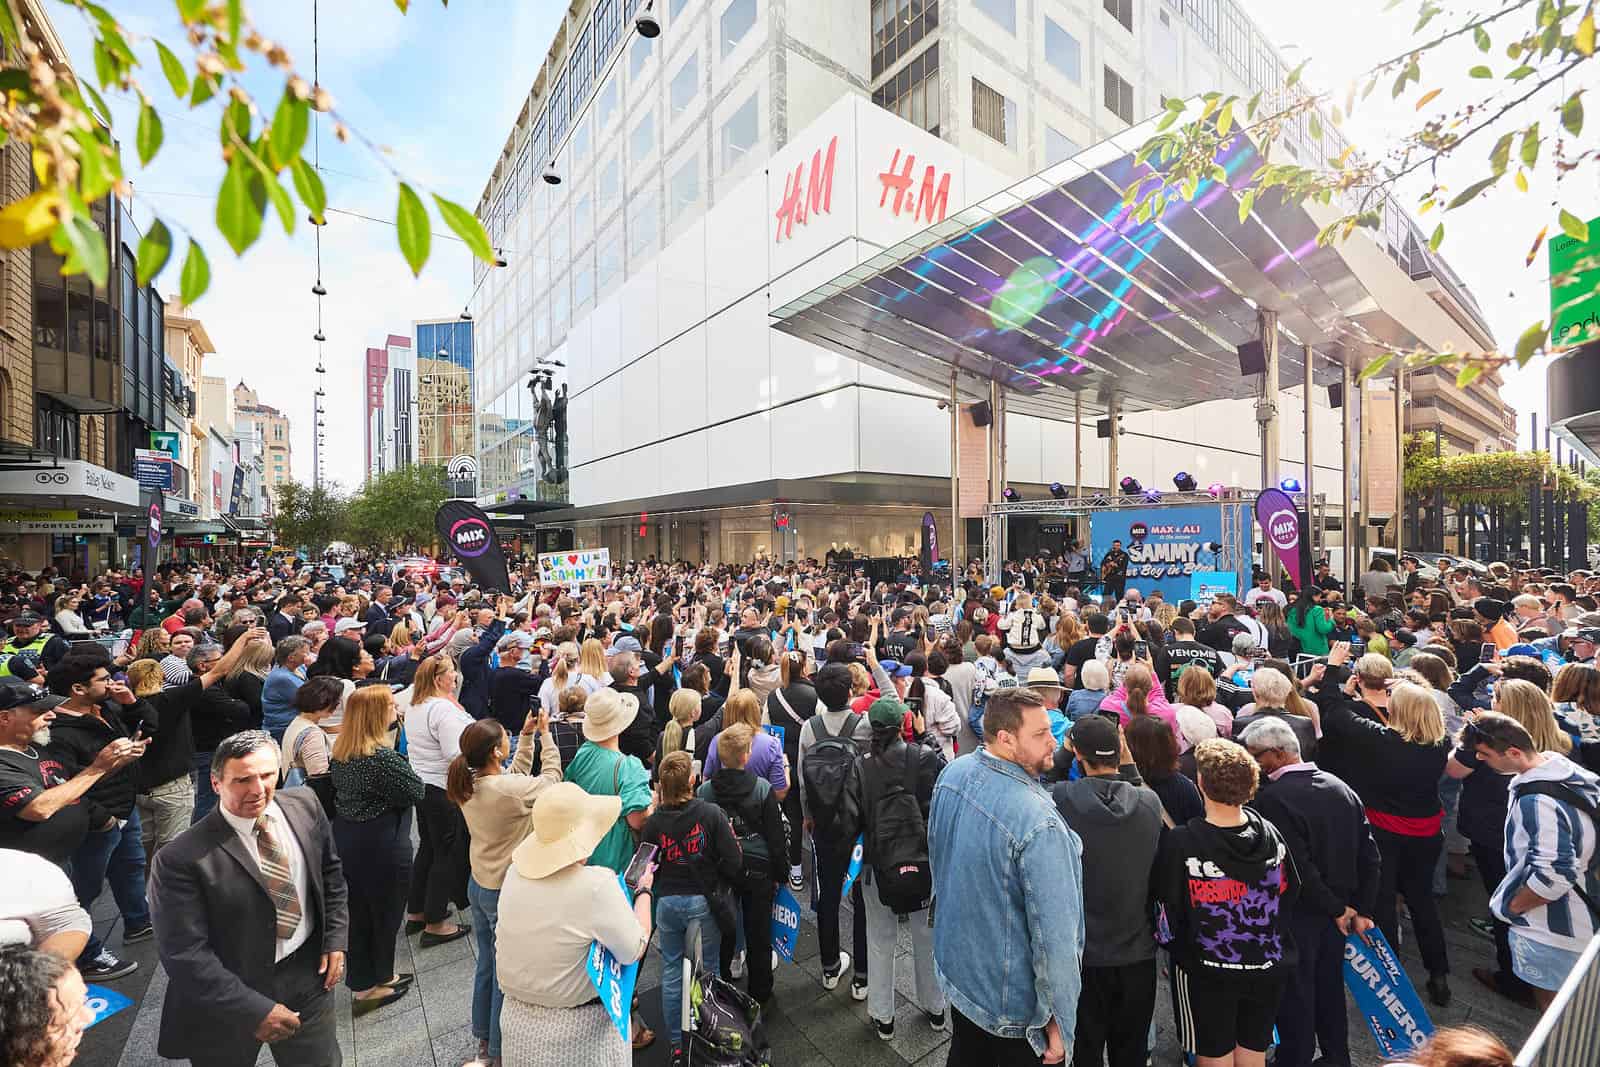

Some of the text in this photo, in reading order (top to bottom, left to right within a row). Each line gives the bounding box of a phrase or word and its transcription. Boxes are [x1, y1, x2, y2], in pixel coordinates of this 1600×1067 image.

[776, 135, 838, 242] H&M
[879, 148, 951, 224] H&M
[456, 529, 485, 545] MIX
[1151, 526, 1173, 534] MAX
[1183, 525, 1200, 534] ALI
[1273, 520, 1295, 537] MIX
[552, 554, 590, 566] WE U
[1128, 542, 1200, 563] SAMMY
[551, 565, 595, 581] SAMMY
[1140, 564, 1164, 579] Boy
[1166, 564, 1180, 576] in
[771, 903, 797, 929] HERO
[1344, 942, 1381, 990] OUR
[1375, 984, 1427, 1050] HERO
